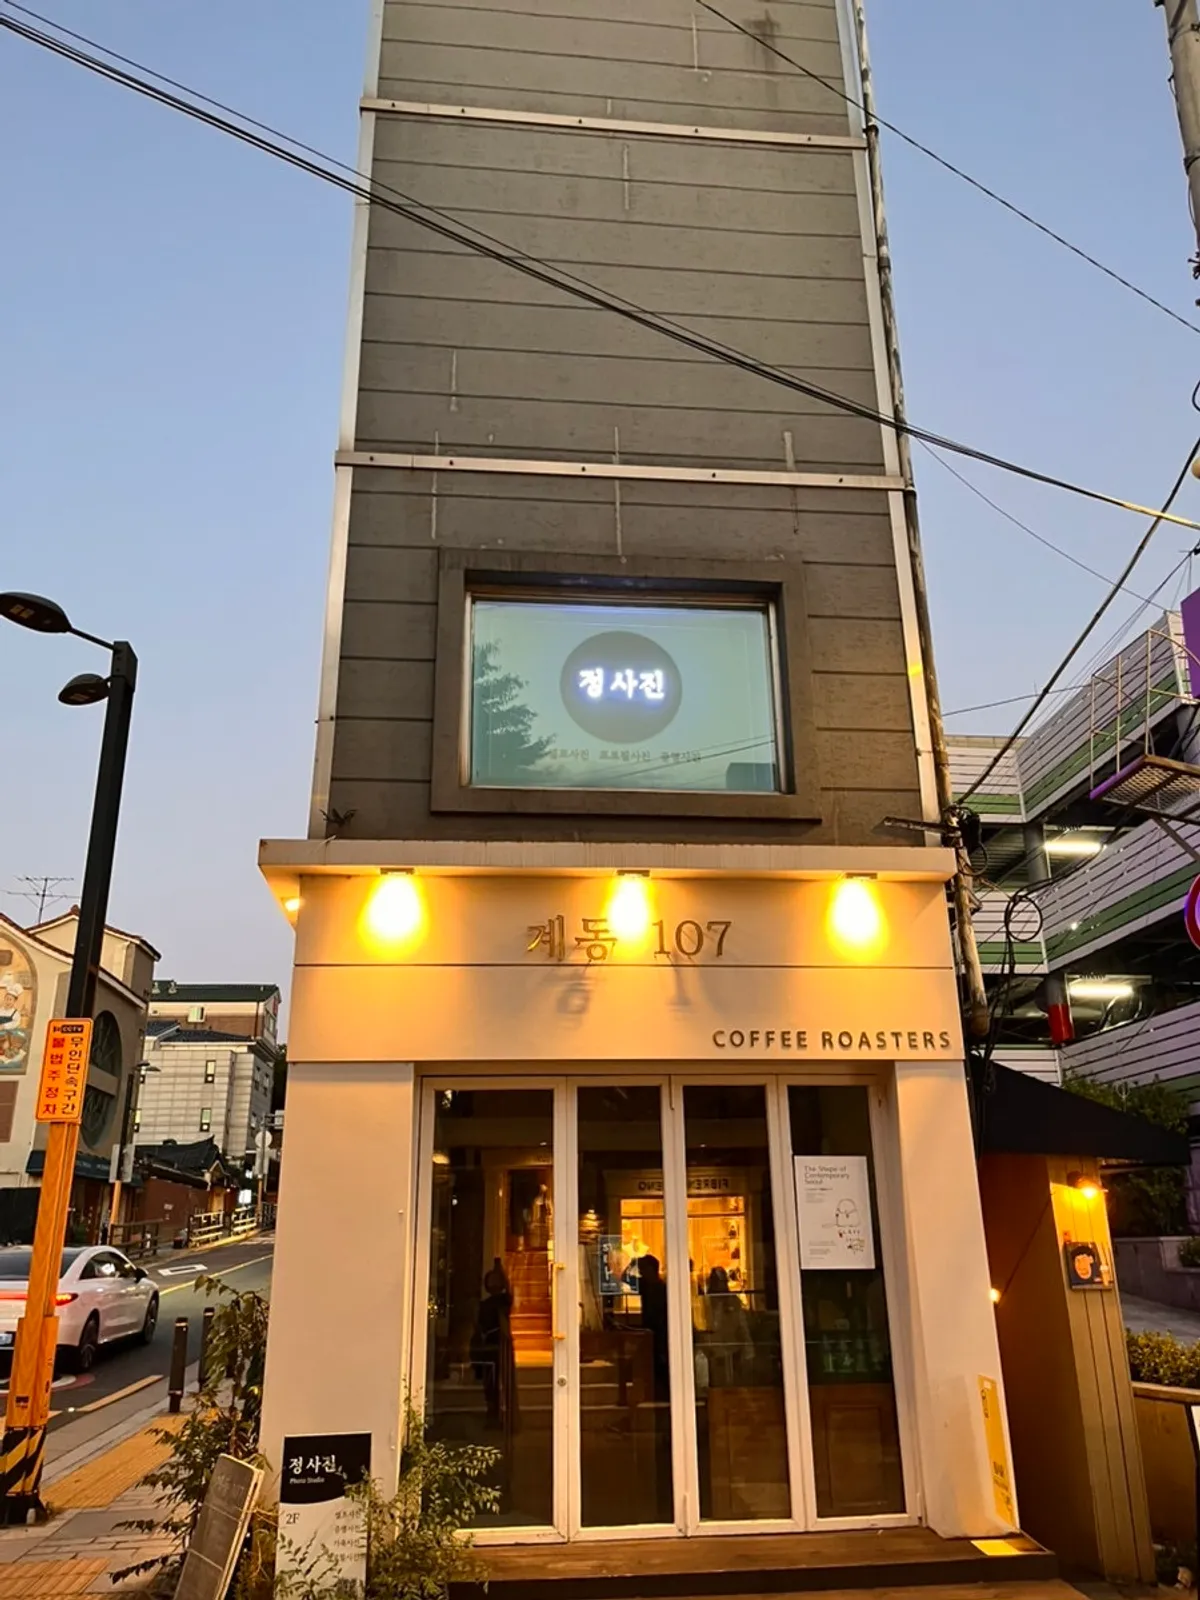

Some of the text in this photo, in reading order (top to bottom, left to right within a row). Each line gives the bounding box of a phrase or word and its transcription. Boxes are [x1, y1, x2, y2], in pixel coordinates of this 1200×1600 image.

[652, 919, 732, 959] 107
[712, 1030, 951, 1050] COFFEE ROASTERS
[42, 1037, 65, 1115] 불법주정차
[61, 1036, 84, 1115] 무인단속구간
[804, 1172, 850, 1180] Contemporary
[307, 1475, 325, 1484] Studio
[285, 1512, 300, 1525] 2F
